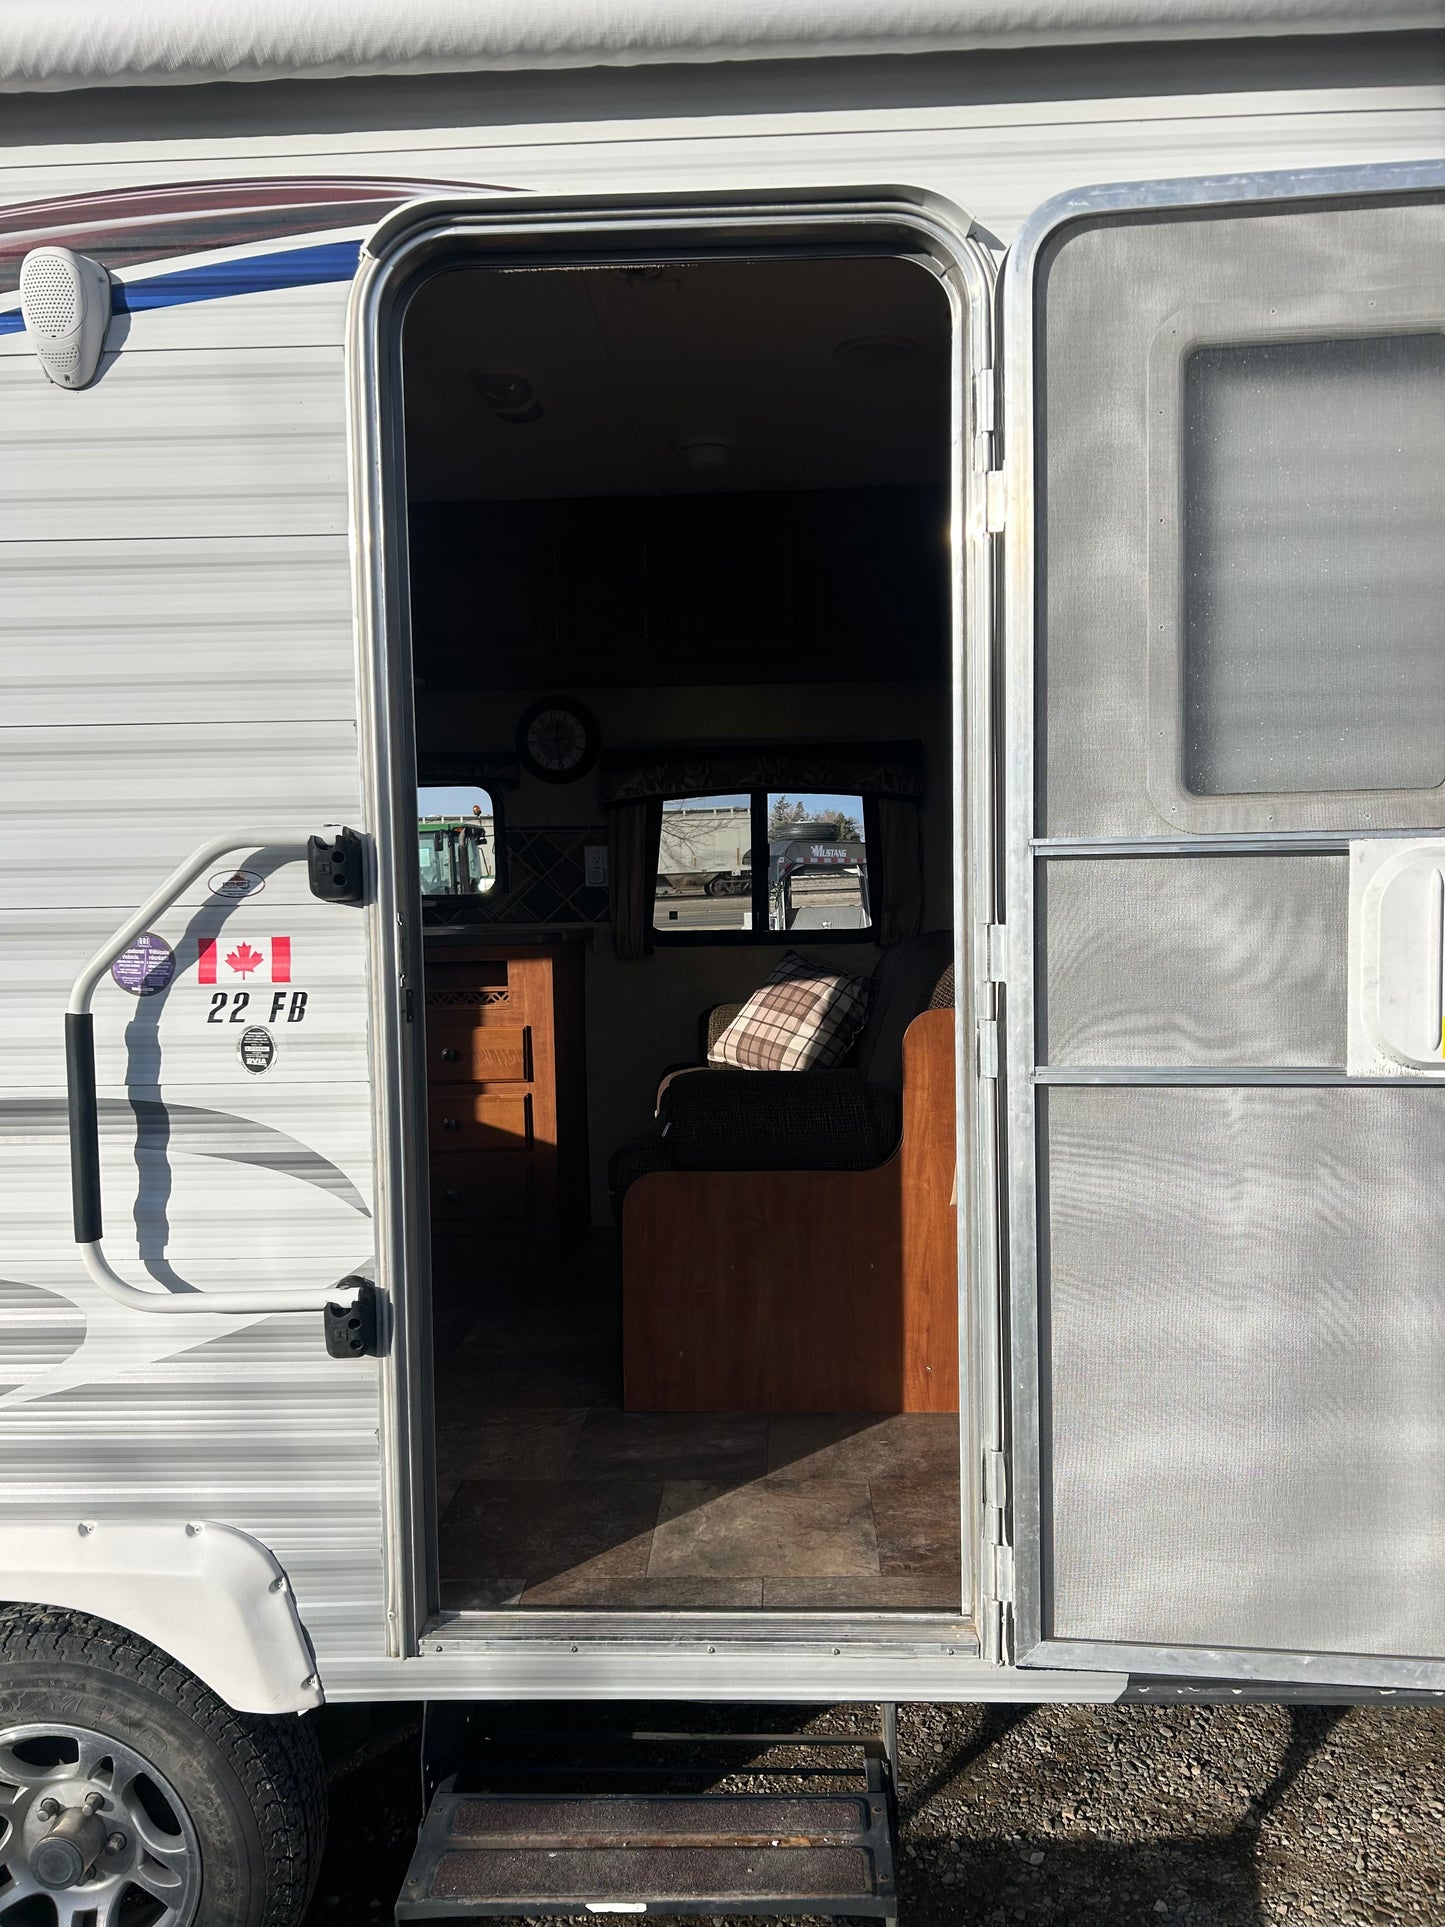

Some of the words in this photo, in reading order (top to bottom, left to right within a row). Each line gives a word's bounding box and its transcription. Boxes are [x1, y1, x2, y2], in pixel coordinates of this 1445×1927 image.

[811, 845, 847, 857] MUSTANG
[207, 992, 250, 1023] 22
[268, 991, 308, 1023] FB
